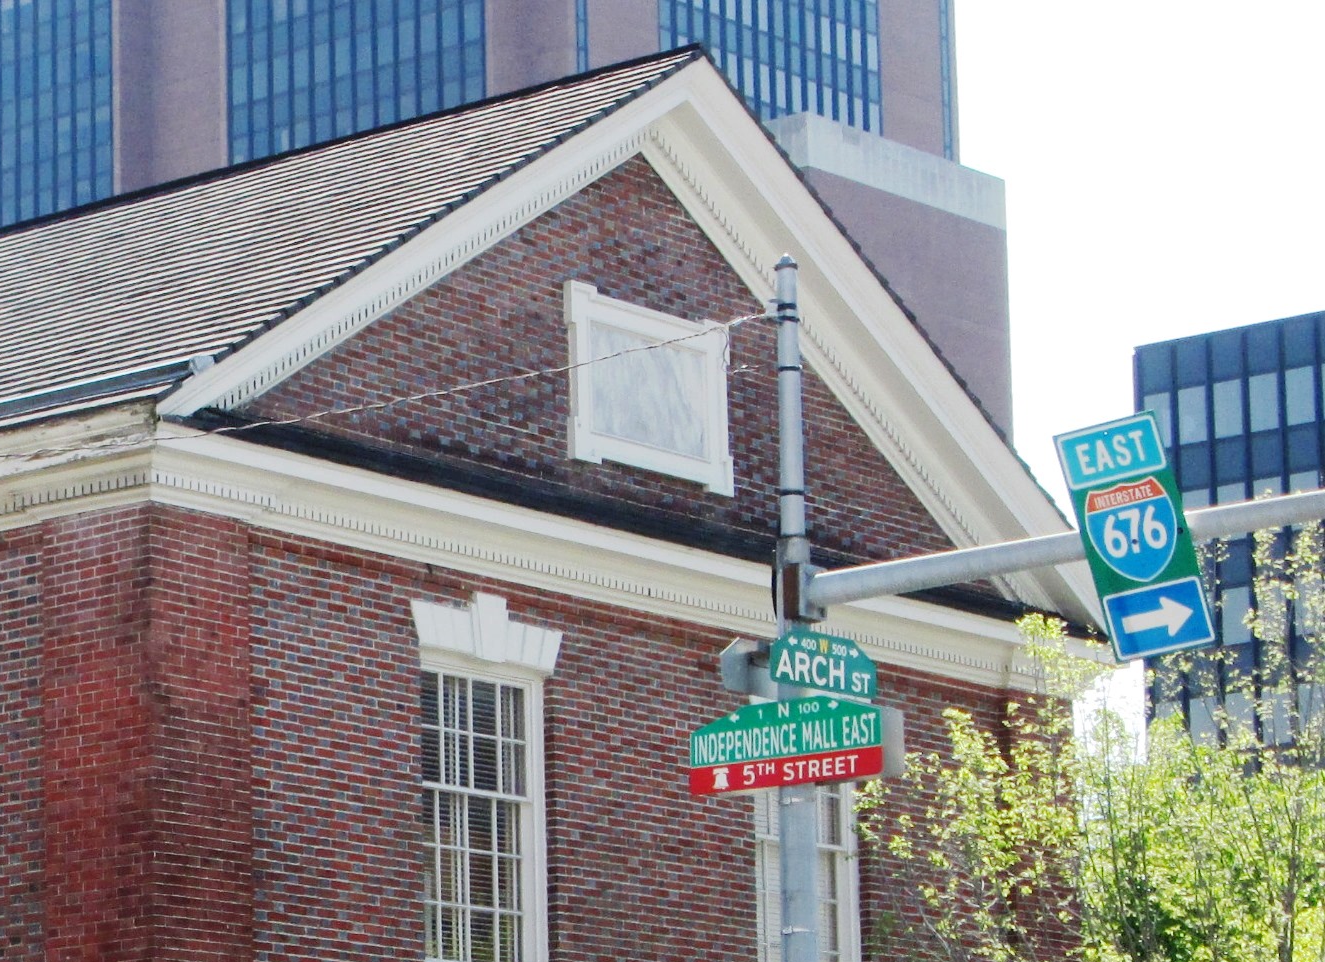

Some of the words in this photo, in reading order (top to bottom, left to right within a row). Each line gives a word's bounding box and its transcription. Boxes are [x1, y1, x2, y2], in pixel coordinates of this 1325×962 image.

[1075, 430, 1147, 476] EAST
[1094, 485, 1153, 508] INTERSTATE
[1104, 505, 1167, 558] 676
[801, 638, 817, 651] 400
[819, 639, 829, 654] W
[831, 643, 847, 656] 500
[776, 649, 845, 690] ARCH
[851, 673, 871, 694] ST
[758, 710, 763, 719] 1
[778, 703, 790, 718] N
[798, 702, 820, 715] 100
[694, 723, 797, 764] INDEPENDENCE
[802, 716, 838, 752] MALL
[842, 712, 876, 746] EAST
[743, 763, 775, 786] 5TH
[783, 755, 859, 781] STREET
